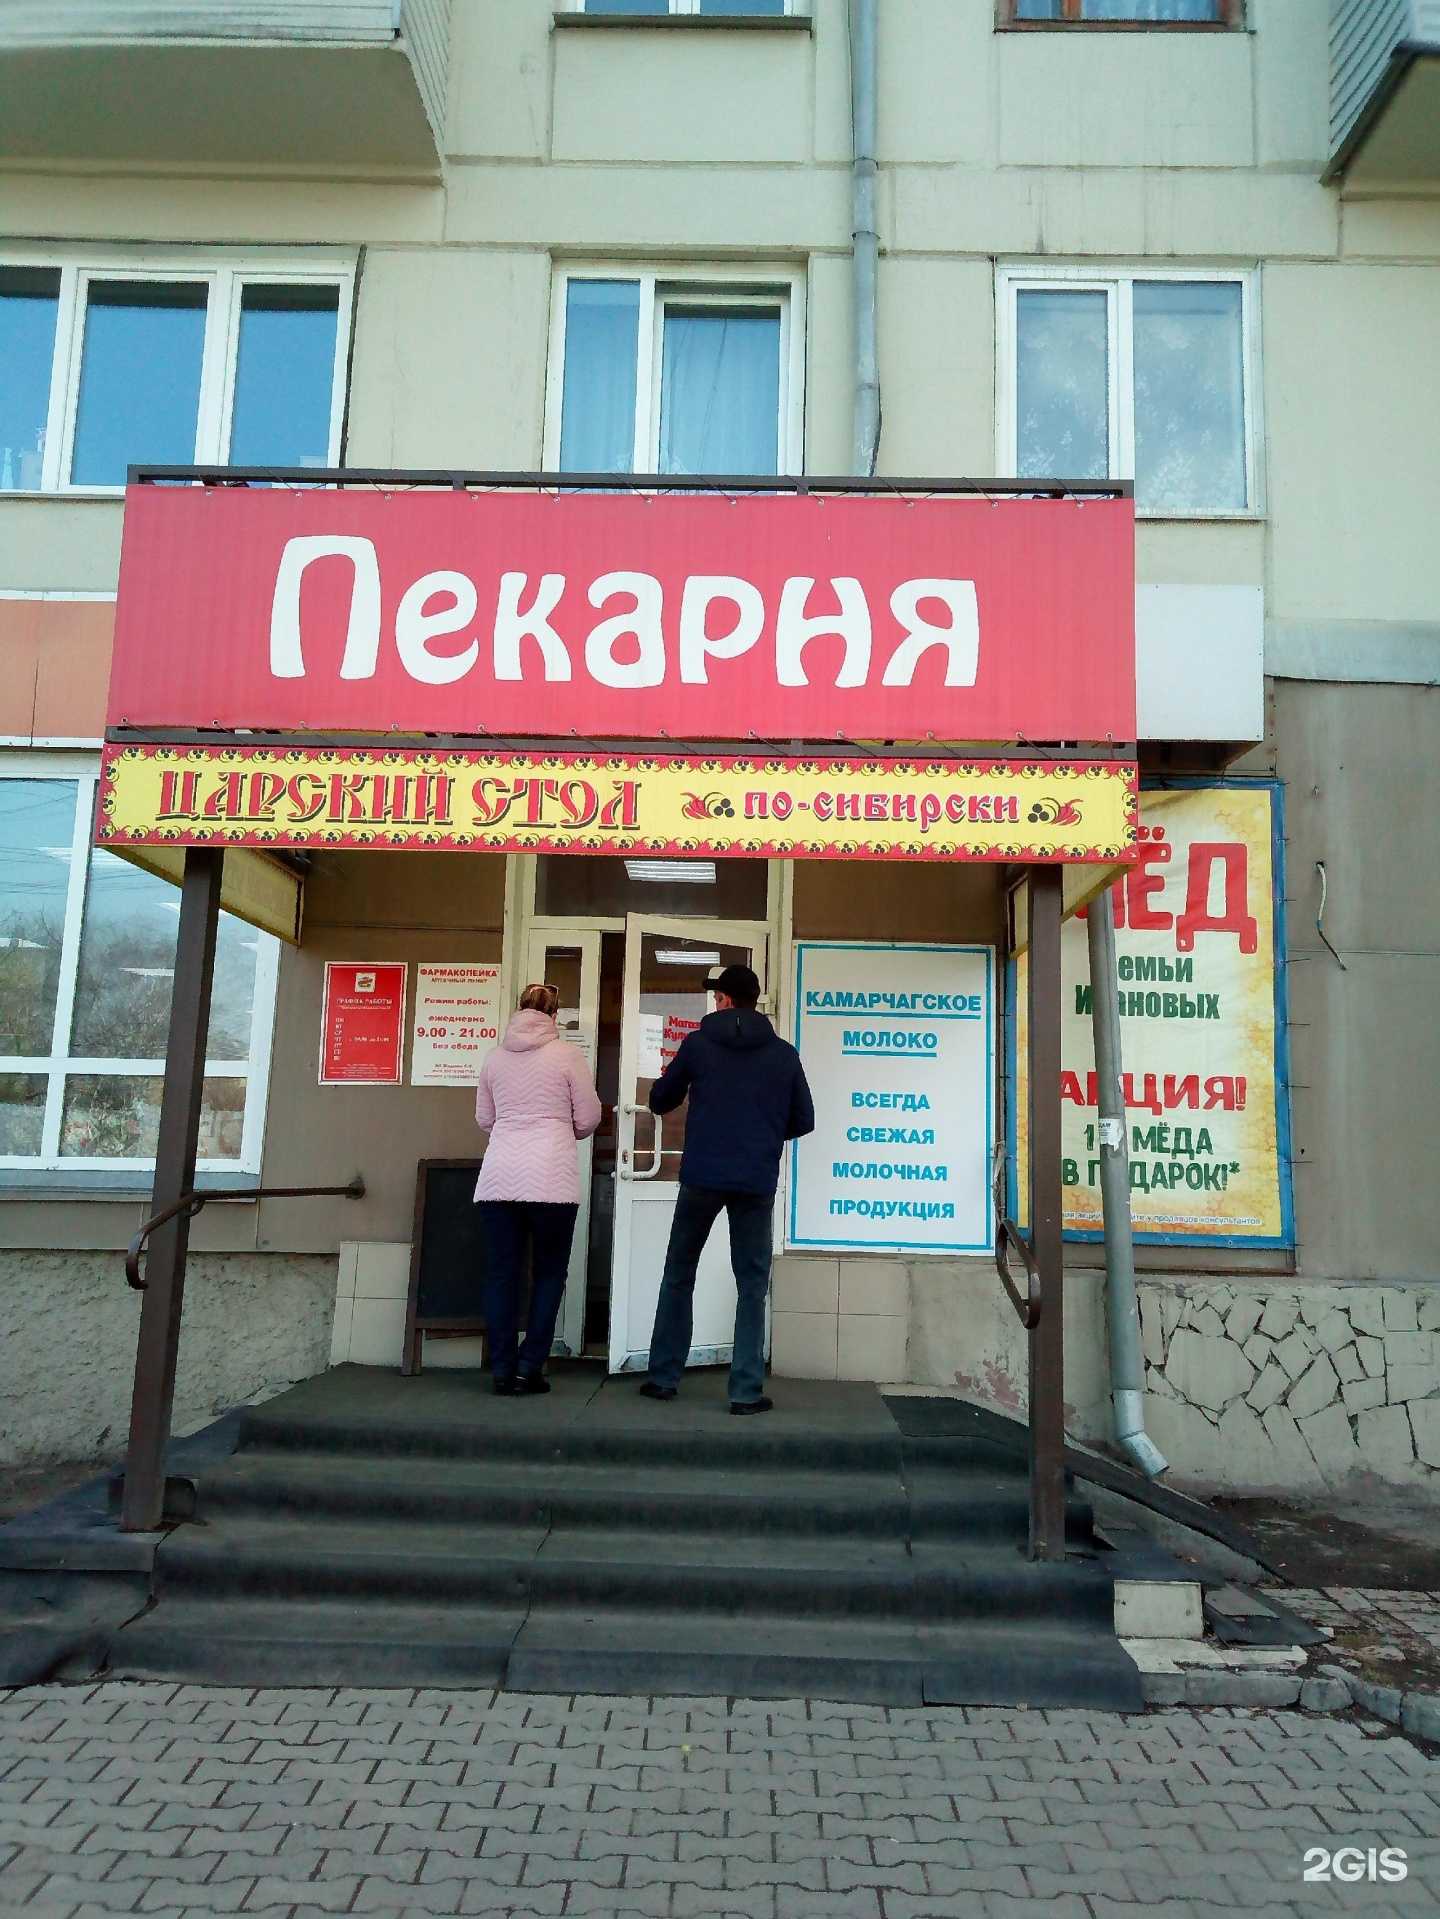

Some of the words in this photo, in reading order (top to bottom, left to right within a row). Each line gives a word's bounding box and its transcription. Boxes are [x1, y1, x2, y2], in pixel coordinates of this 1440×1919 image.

[269, 534, 980, 689] Пекарня
[156, 768, 456, 826] ЦАРСКИЙ
[471, 776, 640, 830] СТОЛ
[1075, 826, 1258, 954] ЁД
[420, 968, 497, 977] ФАРМАКОПЕЙКА
[1117, 955, 1193, 982] емьи
[806, 991, 982, 1012] КАМАРЧАГСКОЕ
[1075, 984, 1221, 1019] Иановых
[428, 1015, 485, 1023] ежедневно
[417, 1027, 447, 1038] 9.00
[459, 1028, 497, 1039] 21.00
[843, 1030, 938, 1049] МОЛОКО
[851, 1092, 931, 1112] ВСЕГДА
[846, 1126, 935, 1144] СВЕЖАЯ
[1132, 1122, 1214, 1160] МЁДА
[832, 1162, 948, 1181] МОЛОЧНАЯ
[1062, 1158, 1080, 1186] В
[829, 1199, 955, 1220] ПРОДУКЦИЯ
